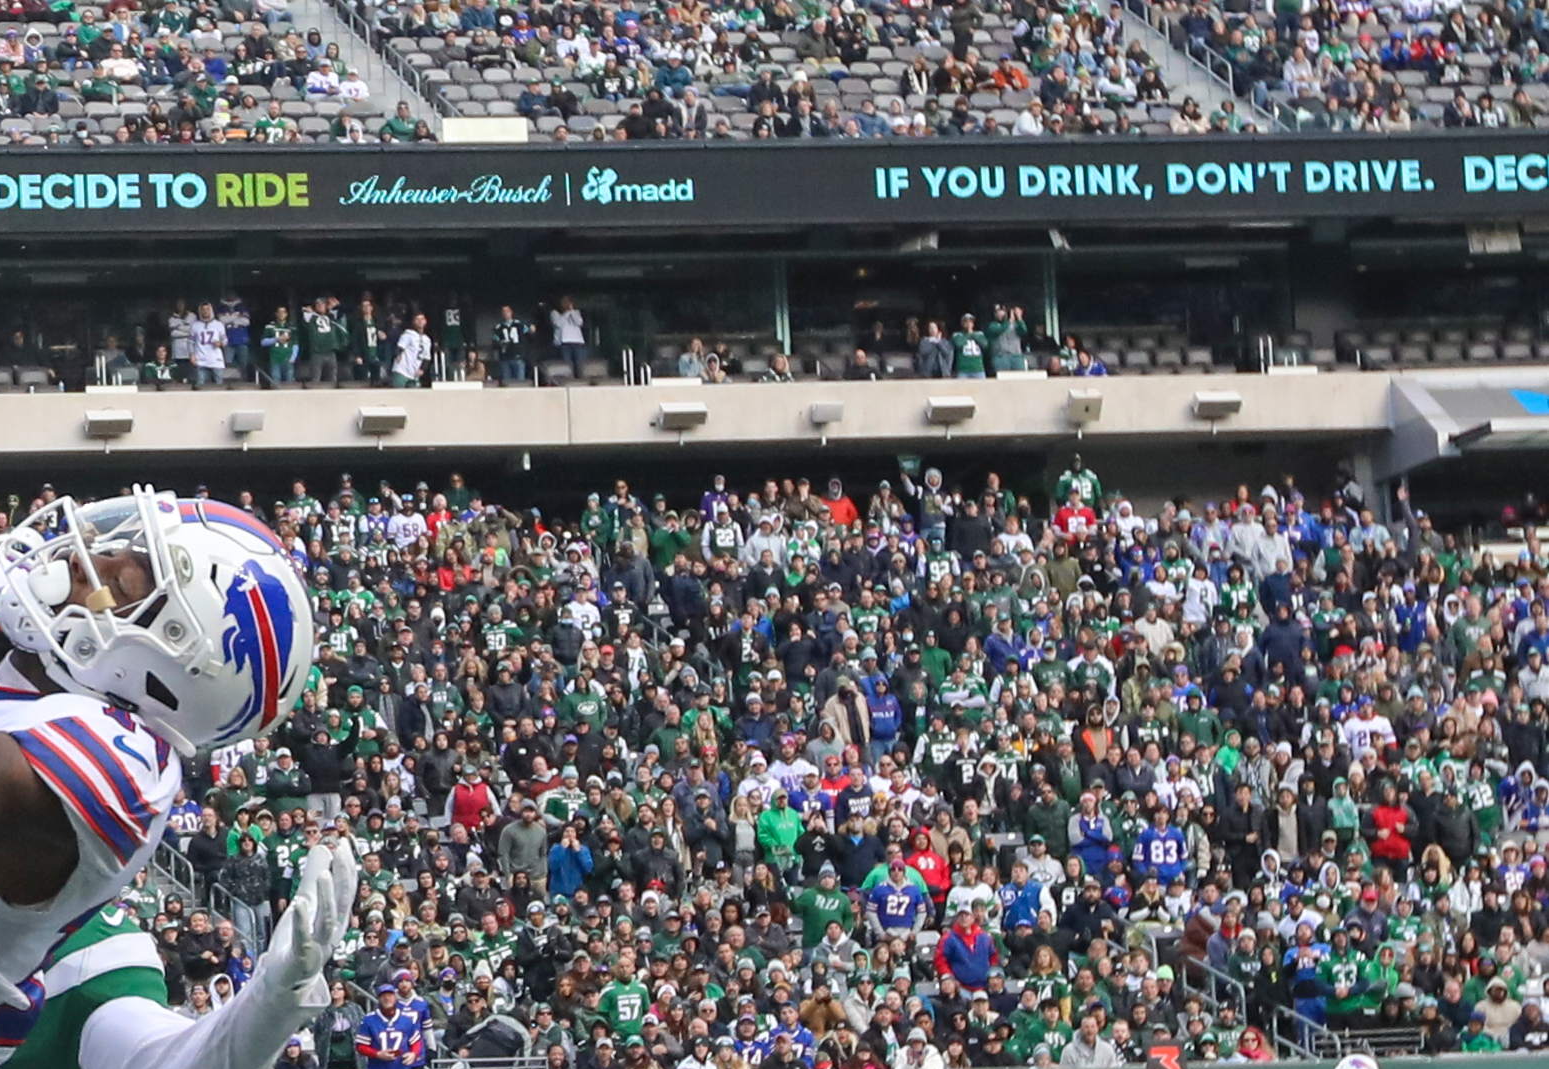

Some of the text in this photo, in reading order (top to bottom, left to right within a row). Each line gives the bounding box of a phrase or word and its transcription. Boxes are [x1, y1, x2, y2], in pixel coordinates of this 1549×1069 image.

[148, 173, 207, 208] TO
[216, 173, 309, 208] RIDE
[339, 175, 552, 205] Anheuser-Busch
[613, 178, 693, 203] madd
[876, 160, 1434, 200] IF YOU DRINK, DON'T DRIVE.
[199, 331, 214, 342] 17
[716, 529, 736, 547] 22
[963, 765, 974, 783] 2
[1468, 790, 1492, 809] 32
[1151, 840, 1178, 862] 83
[888, 897, 910, 915] 27
[1335, 964, 1357, 986] 33
[618, 998, 641, 1020] 57
[379, 1031, 402, 1050] 17
